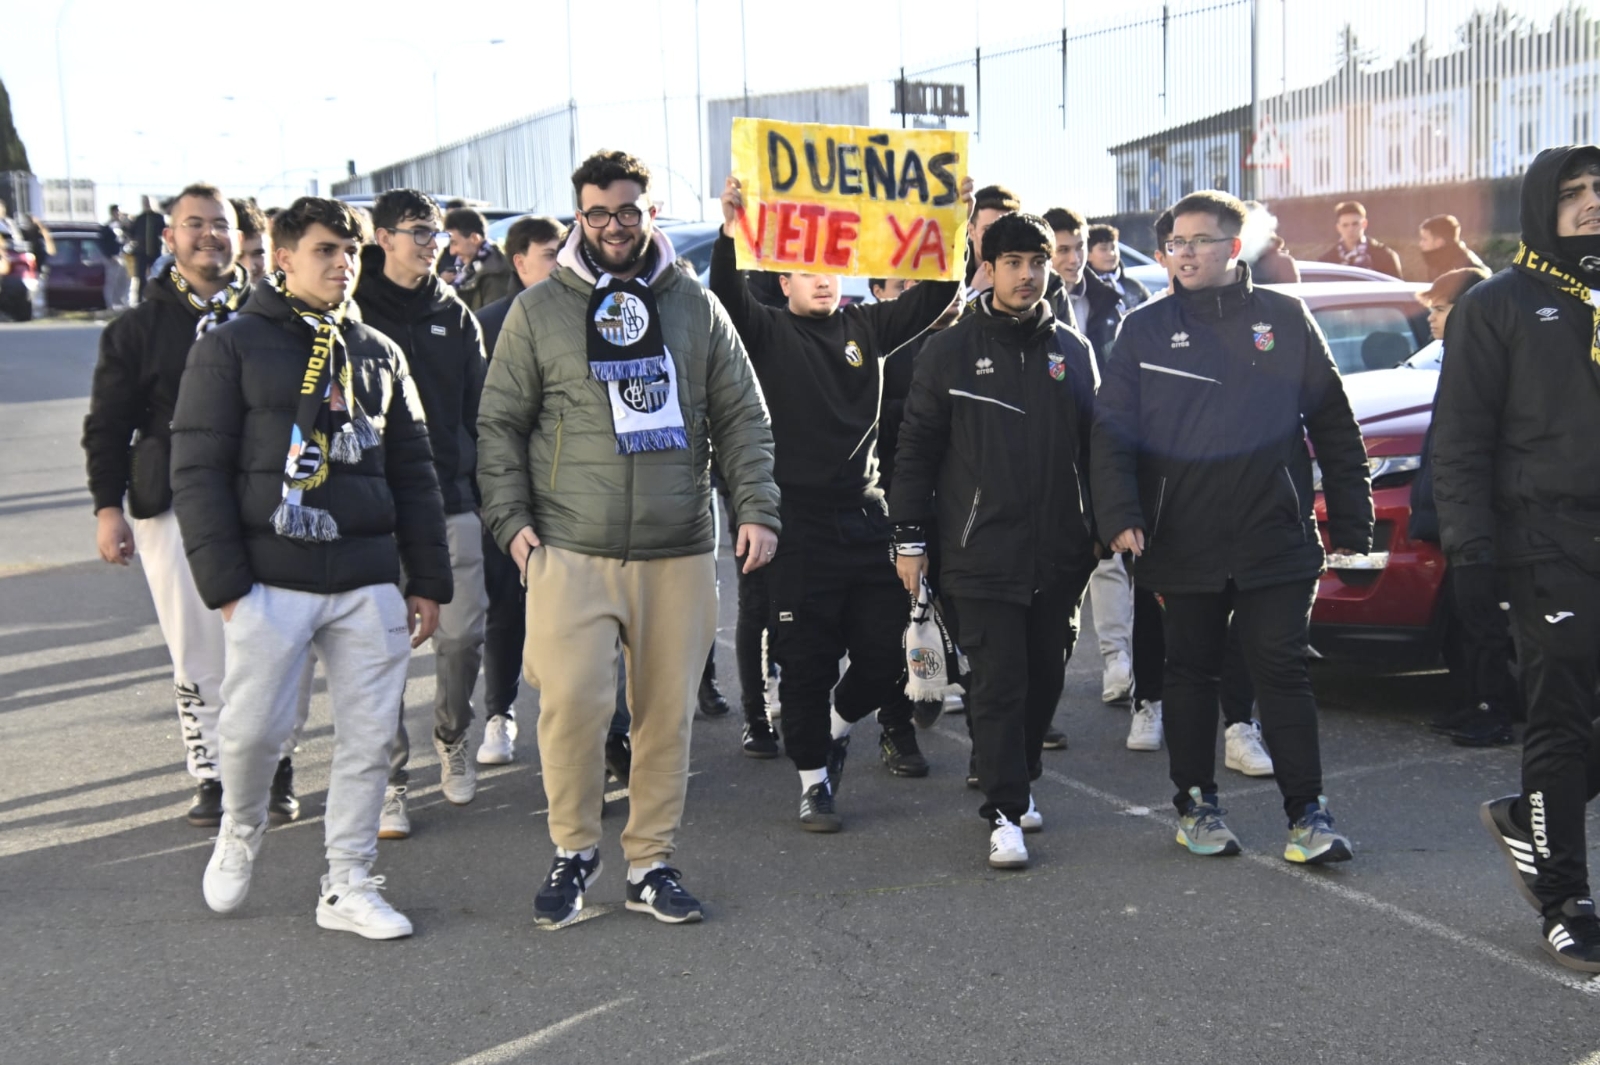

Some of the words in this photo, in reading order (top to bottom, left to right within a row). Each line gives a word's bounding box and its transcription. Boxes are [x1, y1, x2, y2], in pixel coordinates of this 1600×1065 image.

[767, 130, 960, 206] DUEÑAS
[735, 202, 861, 267] VETE
[887, 213, 947, 271] YA
